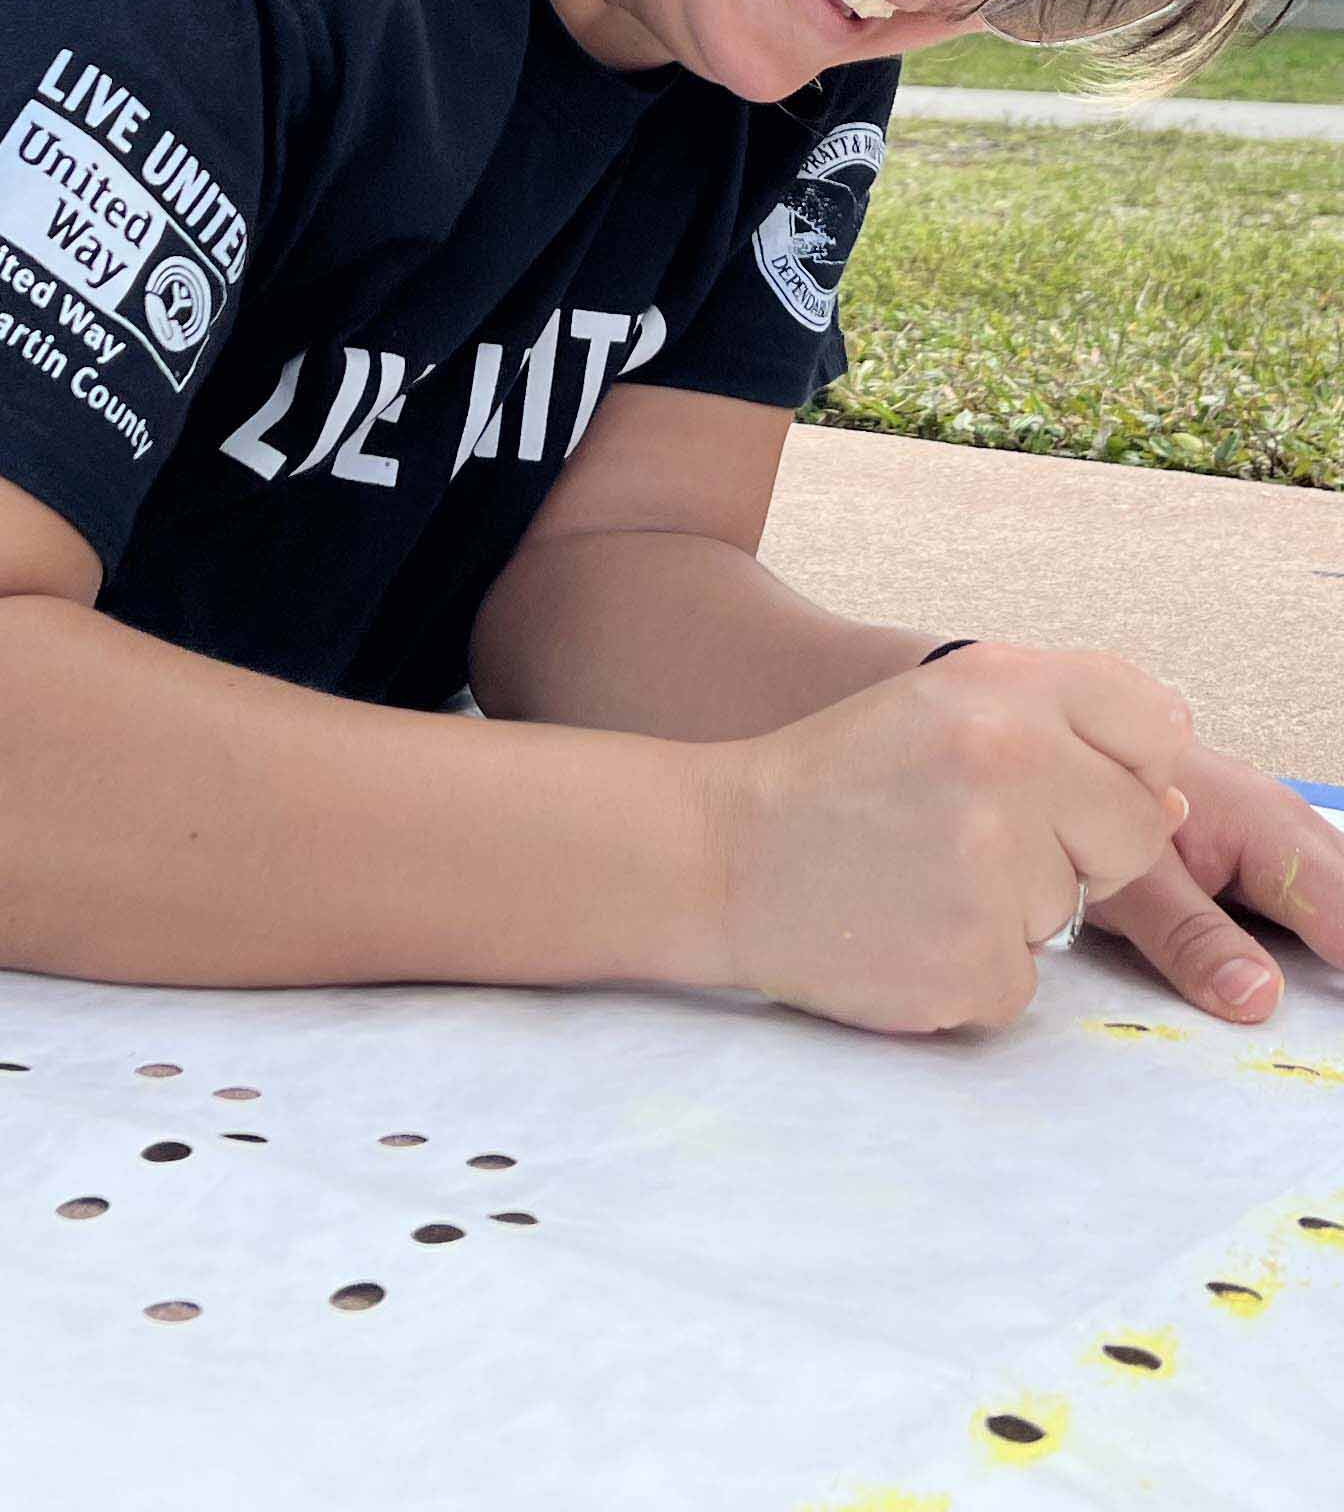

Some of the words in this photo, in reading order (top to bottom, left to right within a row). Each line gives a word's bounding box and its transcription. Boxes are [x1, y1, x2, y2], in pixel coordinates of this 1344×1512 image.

[18, 121, 154, 249] United
[37, 48, 150, 154] LIVE
[142, 130, 248, 285] UNITED
[802, 134, 849, 175] PRATT
[851, 133, 861, 154] &
[46, 199, 128, 289] Way
[58, 294, 127, 365] Way
[70, 365, 155, 461] County
